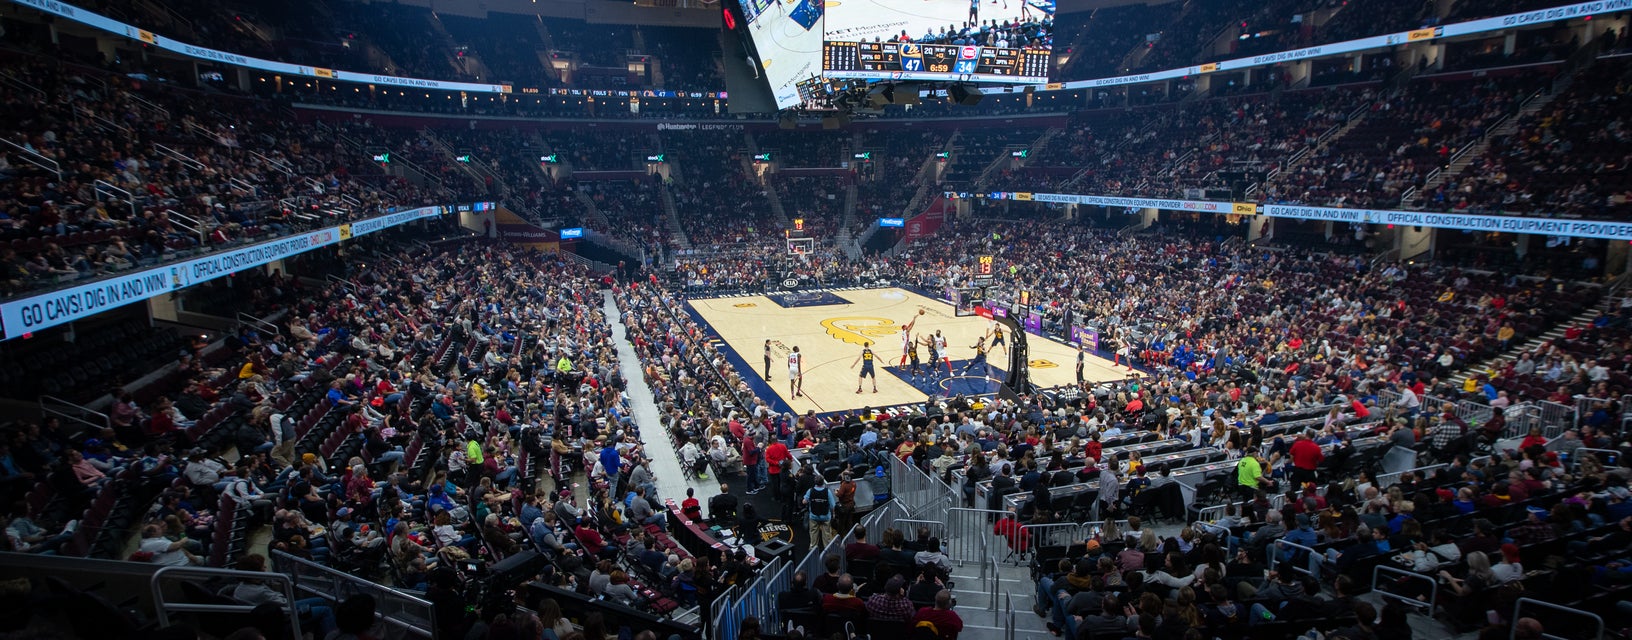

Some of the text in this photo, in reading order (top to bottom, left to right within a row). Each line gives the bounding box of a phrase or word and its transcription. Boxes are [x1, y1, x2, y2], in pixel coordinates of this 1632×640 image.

[1504, 16, 1516, 26] GO
[1518, 12, 1544, 24] CAVS!
[1546, 10, 1563, 19] DIG
[1565, 8, 1577, 16] IN
[1579, 3, 1602, 14] AND
[906, 59, 920, 72] 47
[930, 64, 948, 72] 6:59
[959, 61, 973, 72] 34
[1281, 208, 1299, 216] CAVS!
[1300, 208, 1312, 217] DIG
[1314, 209, 1322, 218] IN
[1323, 210, 1339, 219] AND
[1340, 211, 1358, 220] WIN!
[1388, 213, 1423, 224] OFFICIAL
[1426, 215, 1500, 228] CONSTRUCTION
[1503, 220, 1570, 232] EQUIPMENT
[1572, 222, 1632, 236] PROVIDER
[980, 256, 993, 264] 6:59
[981, 263, 992, 274] 13
[22, 304, 42, 327] GO
[46, 293, 83, 320] CAVS!
[86, 288, 105, 309] DIG
[107, 284, 120, 303] IN
[122, 279, 144, 298] AND
[144, 273, 166, 291] WIN!
[194, 256, 222, 278] OFFICIAL
[224, 249, 264, 270] CONSTRUCTION
[265, 242, 291, 261] EQUIPMENT
[290, 237, 308, 251] PROVIDER
